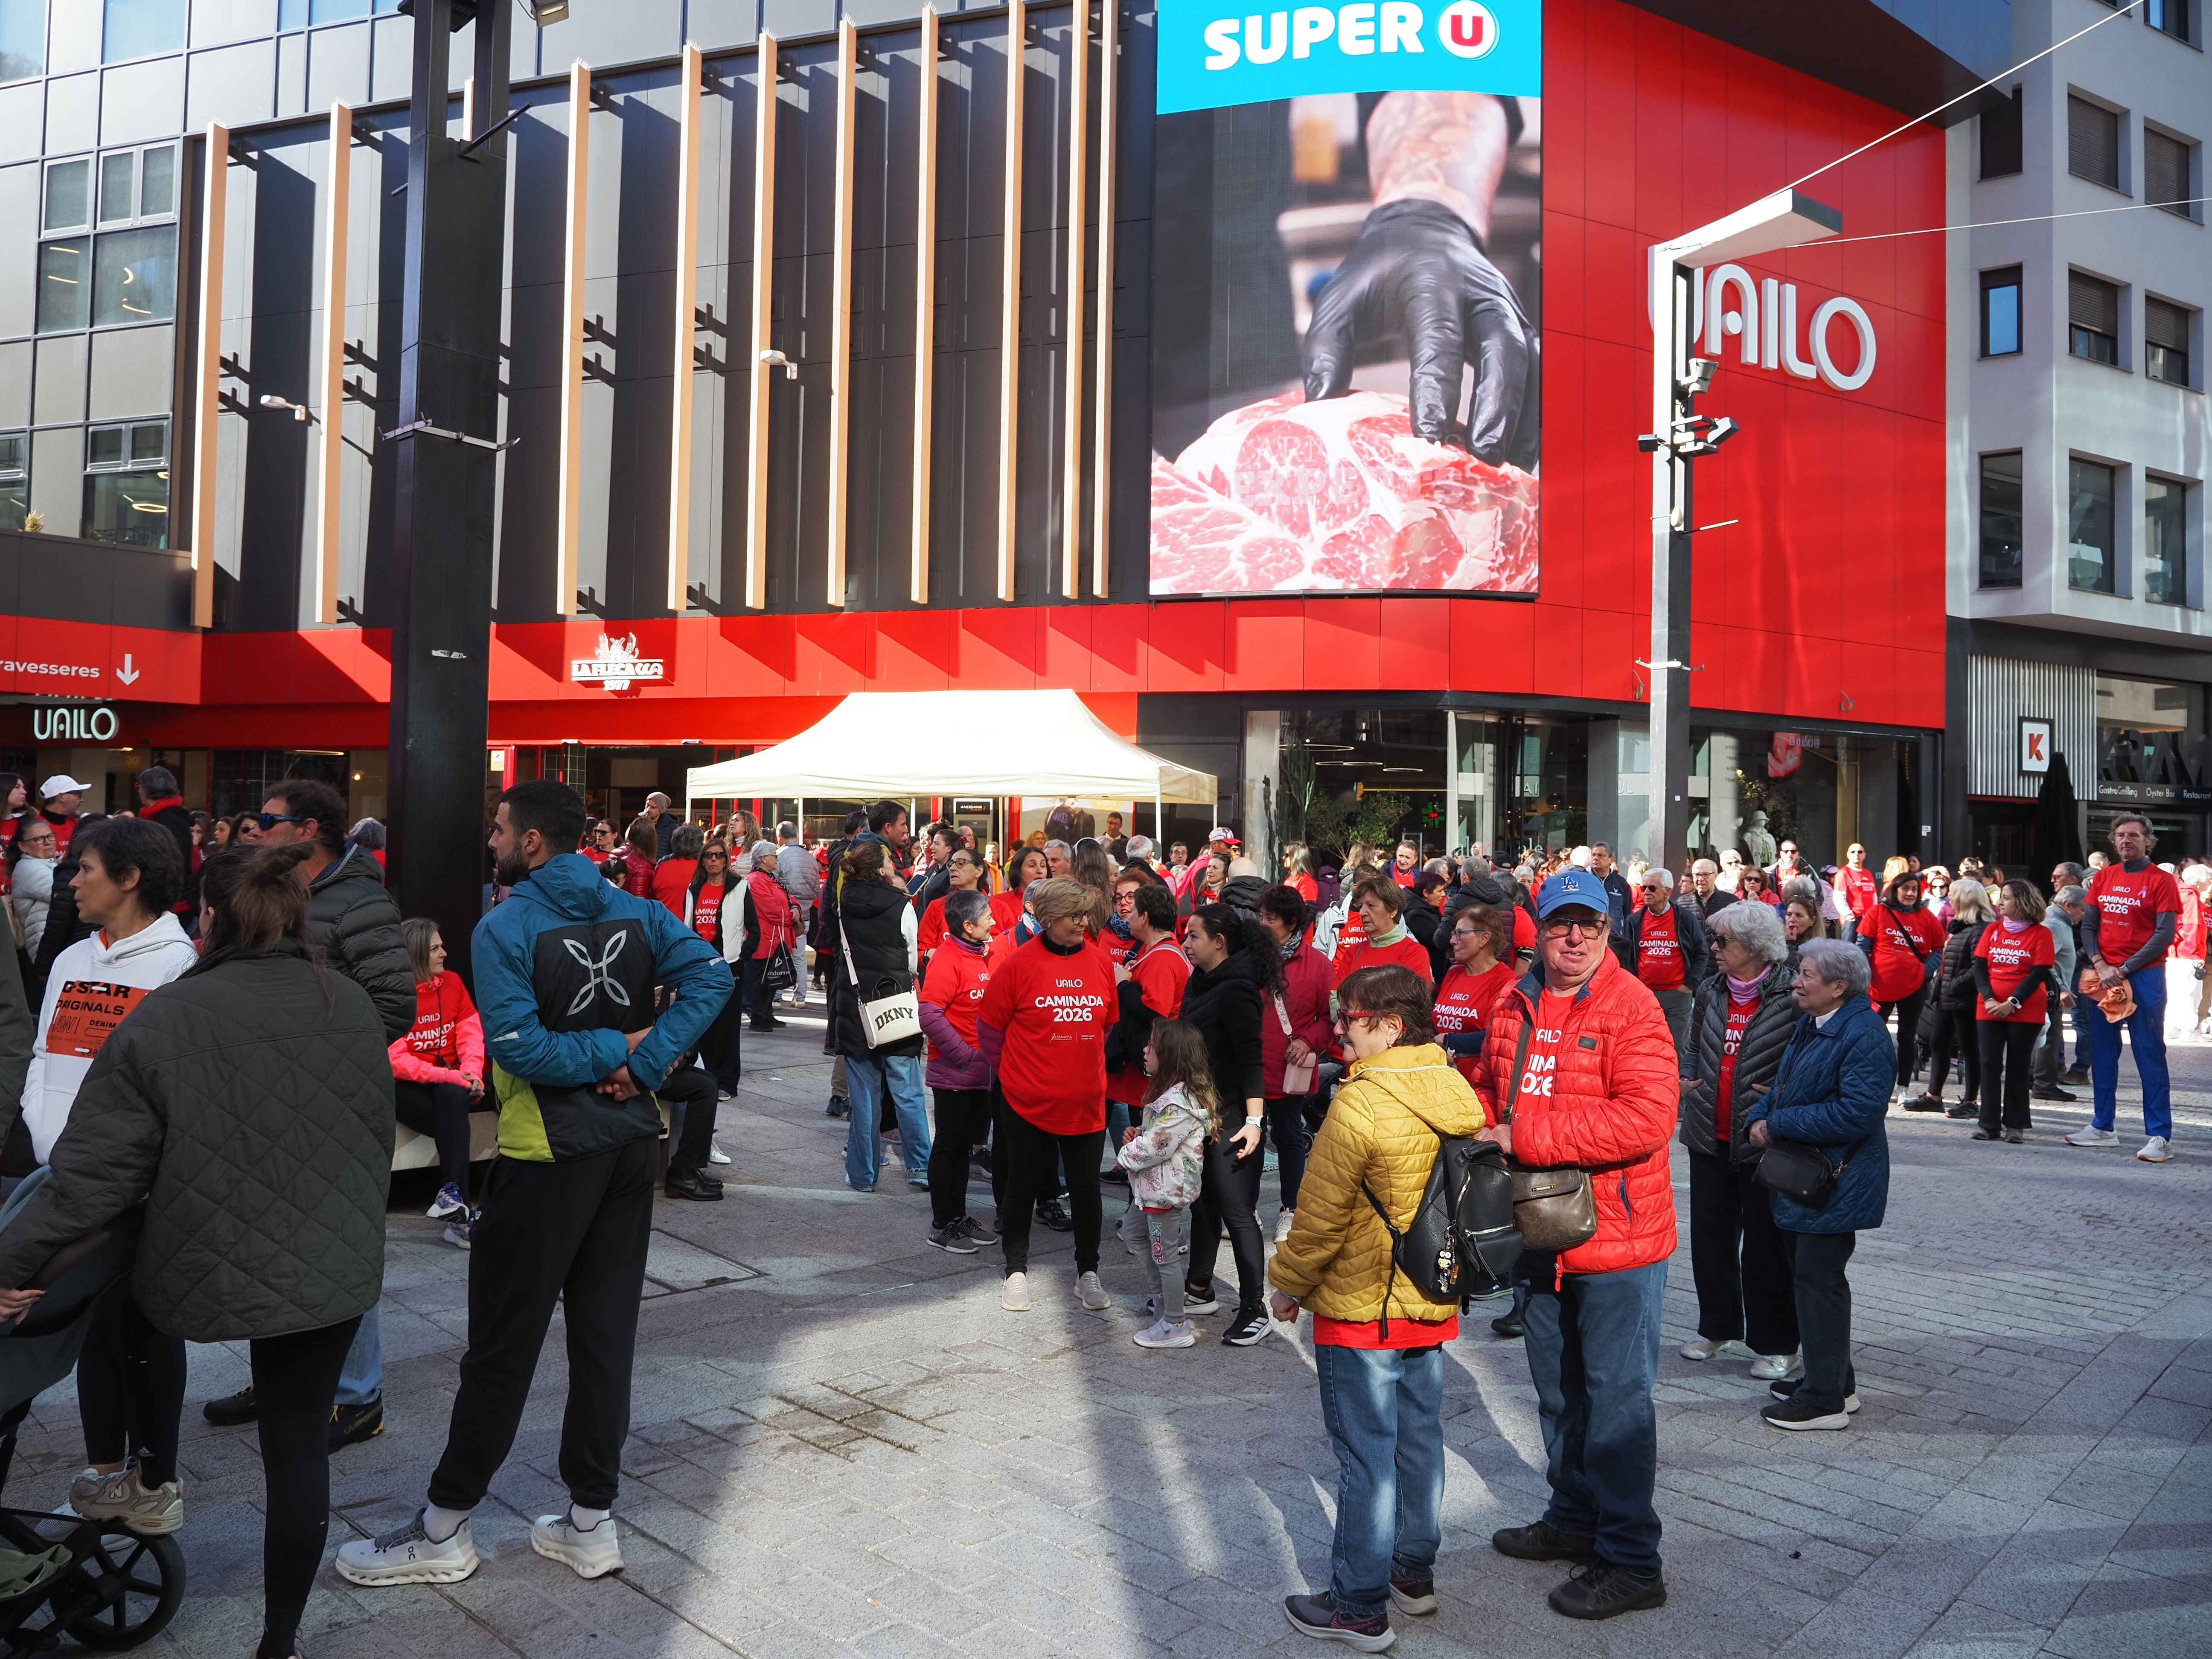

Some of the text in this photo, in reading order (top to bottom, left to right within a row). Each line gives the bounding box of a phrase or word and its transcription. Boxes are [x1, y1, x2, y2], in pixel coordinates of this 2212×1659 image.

[1203, 2, 1484, 71] SUPER U
[602, 679, 631, 691] 1977
[34, 708, 116, 740] UAILO
[2029, 733, 2044, 761] K
[2098, 785, 2138, 798] GastroGrilling
[2146, 787, 2164, 797] Oyster
[2098, 895, 2141, 907] CAMINADA
[2103, 904, 2128, 914] 2026
[1639, 940, 1679, 948] CAMINADA
[1647, 946, 1671, 956] 2026
[1992, 954, 2019, 965] 2026
[1056, 979, 1083, 988] UAILO
[1035, 995, 1104, 1008] CAMINADA
[1450, 992, 1469, 1001] UAILO
[875, 1007, 914, 1031] DKNY
[1053, 1008, 1093, 1022] 2026
[1436, 1014, 1463, 1030] 2026
